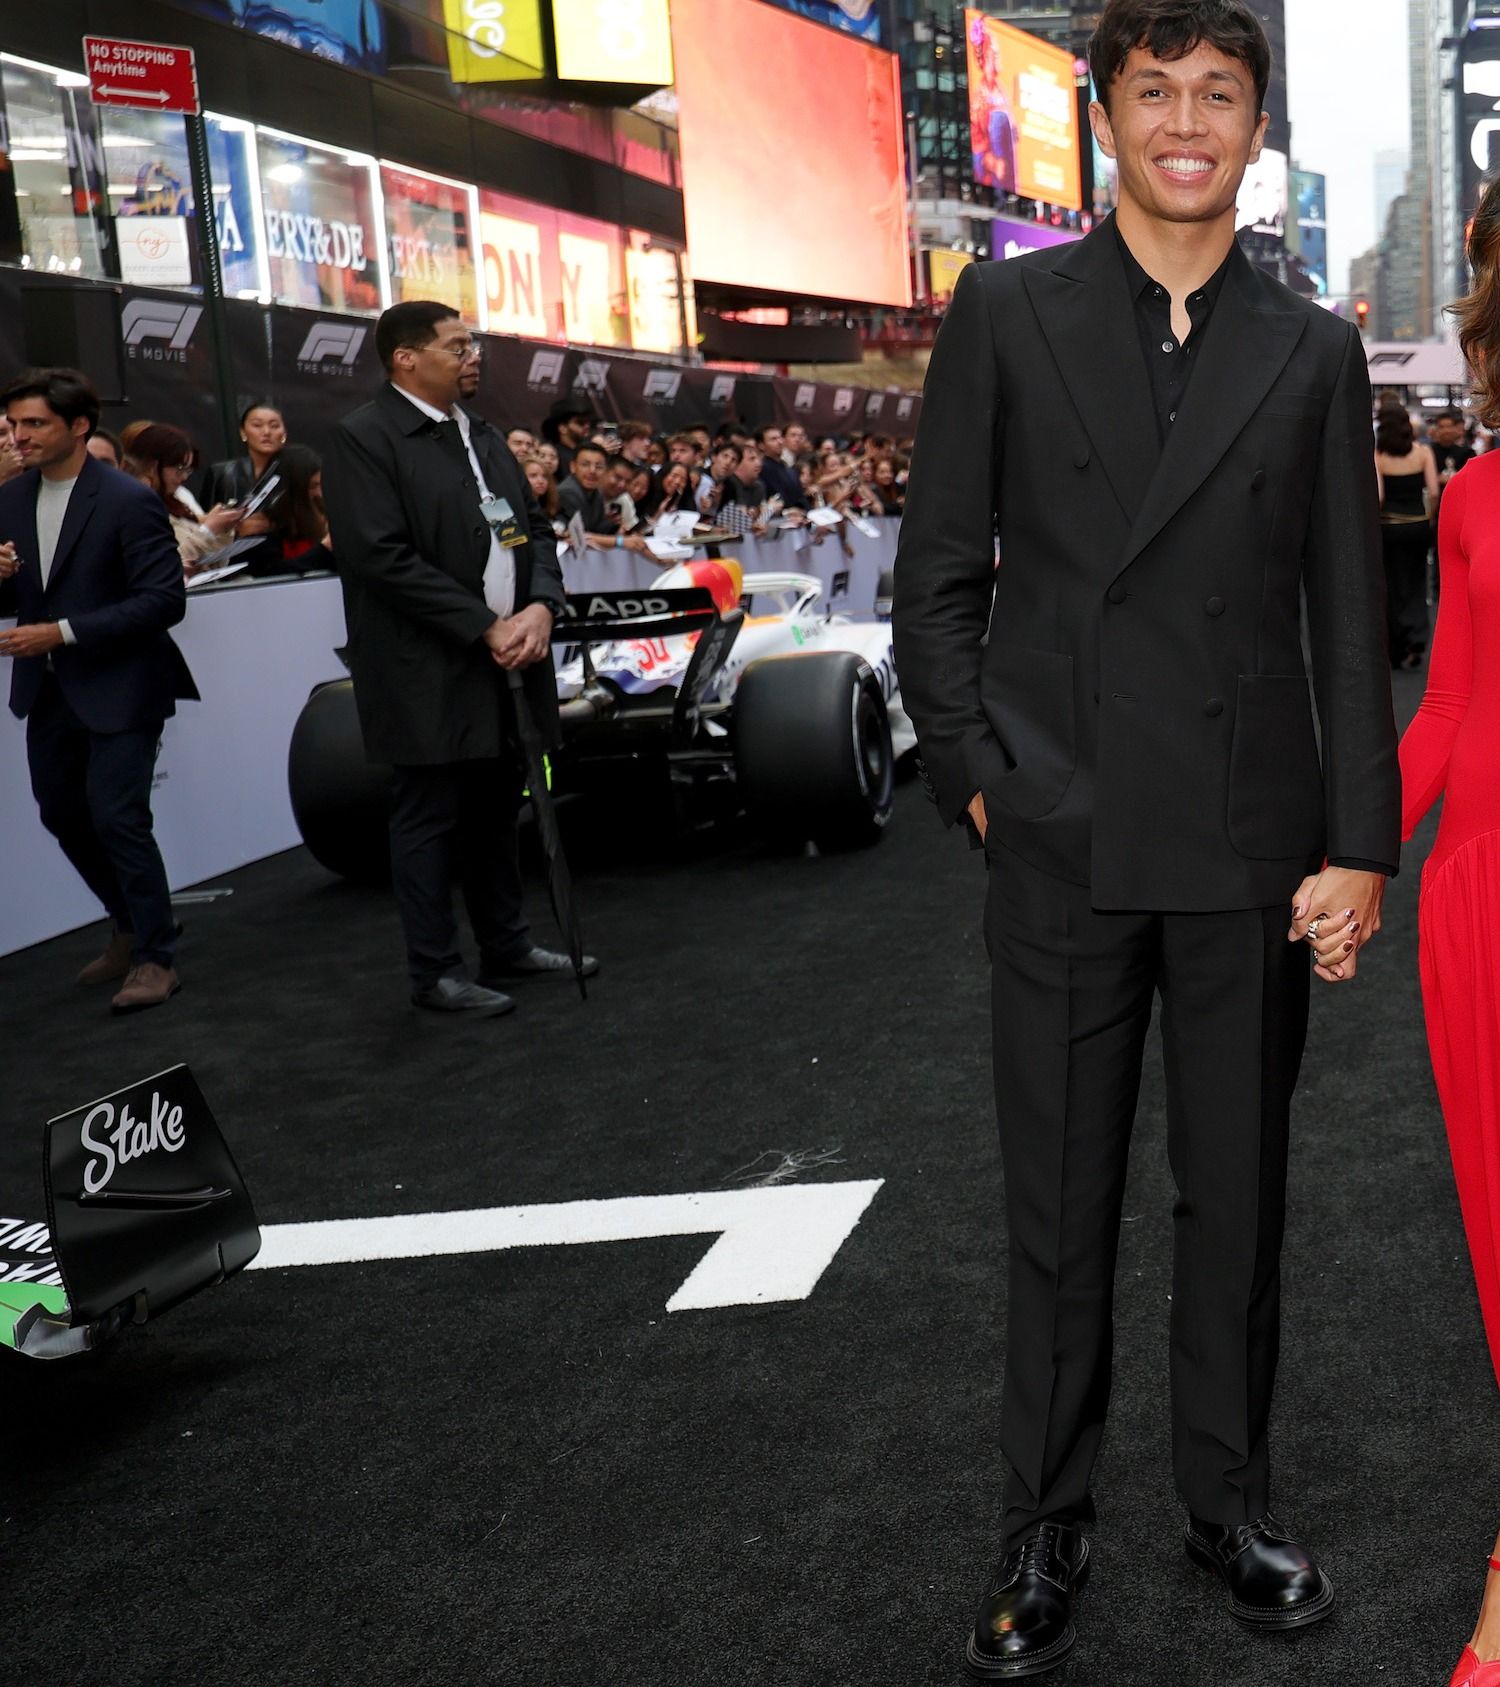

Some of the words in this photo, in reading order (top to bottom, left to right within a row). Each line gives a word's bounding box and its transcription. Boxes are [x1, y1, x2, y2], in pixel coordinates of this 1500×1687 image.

[90, 44, 110, 59] NO
[112, 46, 176, 66] STOPPING
[93, 59, 147, 77] Anytime
[143, 347, 187, 363] MOVIE
[297, 362, 319, 374] THE
[321, 364, 354, 377] MOVIE
[587, 596, 670, 618] App
[81, 1091, 186, 1194] Stake
